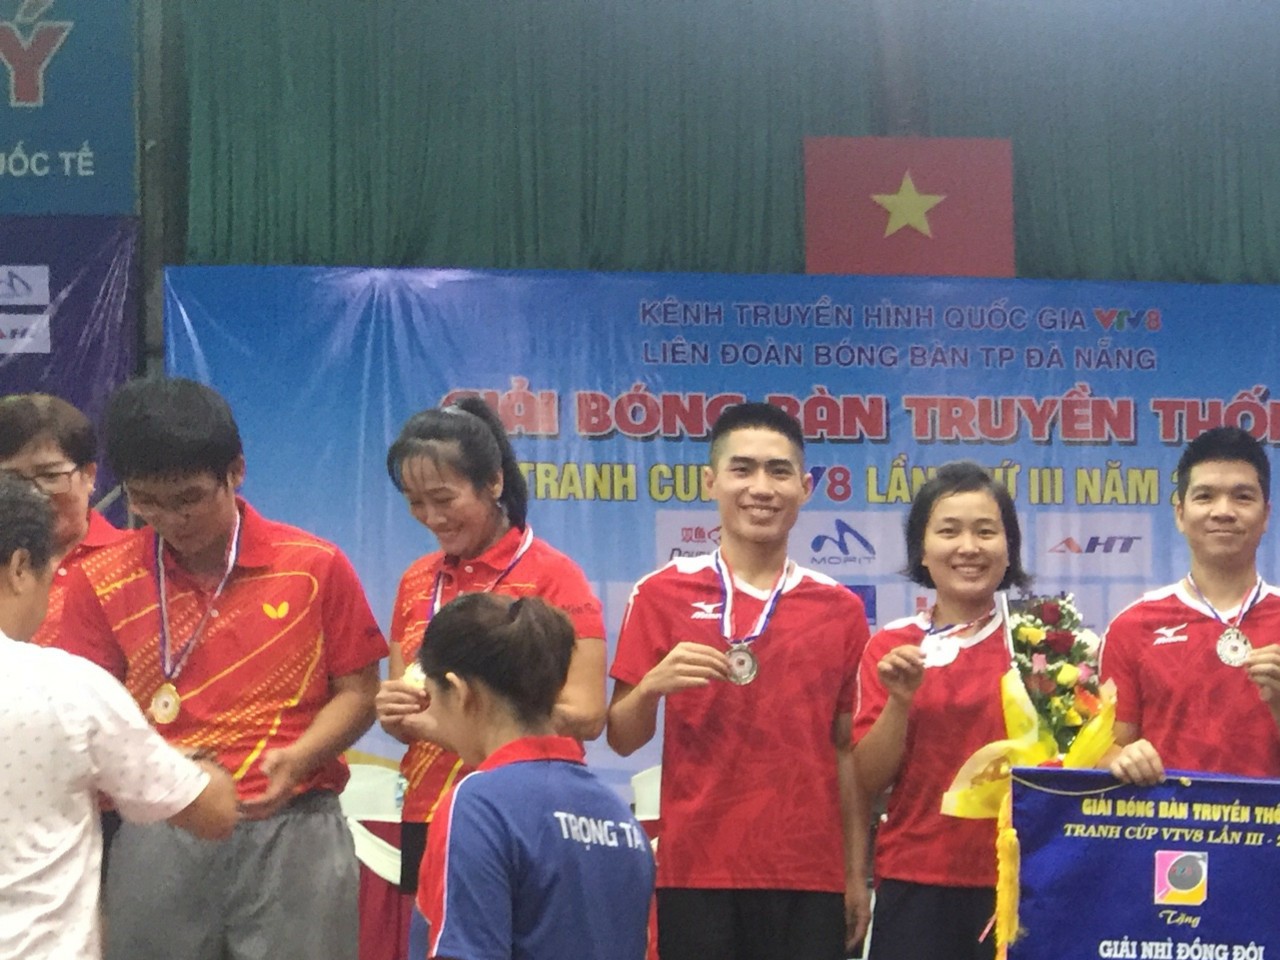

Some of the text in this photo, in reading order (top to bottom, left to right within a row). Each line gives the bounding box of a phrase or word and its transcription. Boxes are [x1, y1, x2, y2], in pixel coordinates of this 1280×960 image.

[59, 140, 95, 177] TẾ
[640, 296, 723, 327] KÊNH
[737, 297, 852, 328] TRUYỀN
[863, 300, 934, 329] HÌNH
[944, 299, 1028, 331] QUỐC
[1037, 309, 1087, 331] GIA
[643, 337, 1158, 370] LIÊN ĐOÀN BÓNG BÀN TP ĐÀ NẴNG
[902, 381, 1136, 443] TRUYỀN
[1028, 467, 1065, 505] III
[1075, 460, 1160, 506] NĂM
[1081, 795, 1112, 816] GIẢI
[1115, 797, 1155, 818] BÓNG
[553, 811, 619, 851] TRỌNG
[1064, 823, 1122, 839] TRANH
[1124, 823, 1158, 840] CÚP
[1160, 827, 1204, 843] VTV8
[1207, 824, 1242, 844] LẦN
[1244, 833, 1265, 846] III
[1098, 935, 1138, 960] GIẢI
[1140, 937, 1173, 960] NHÌ
